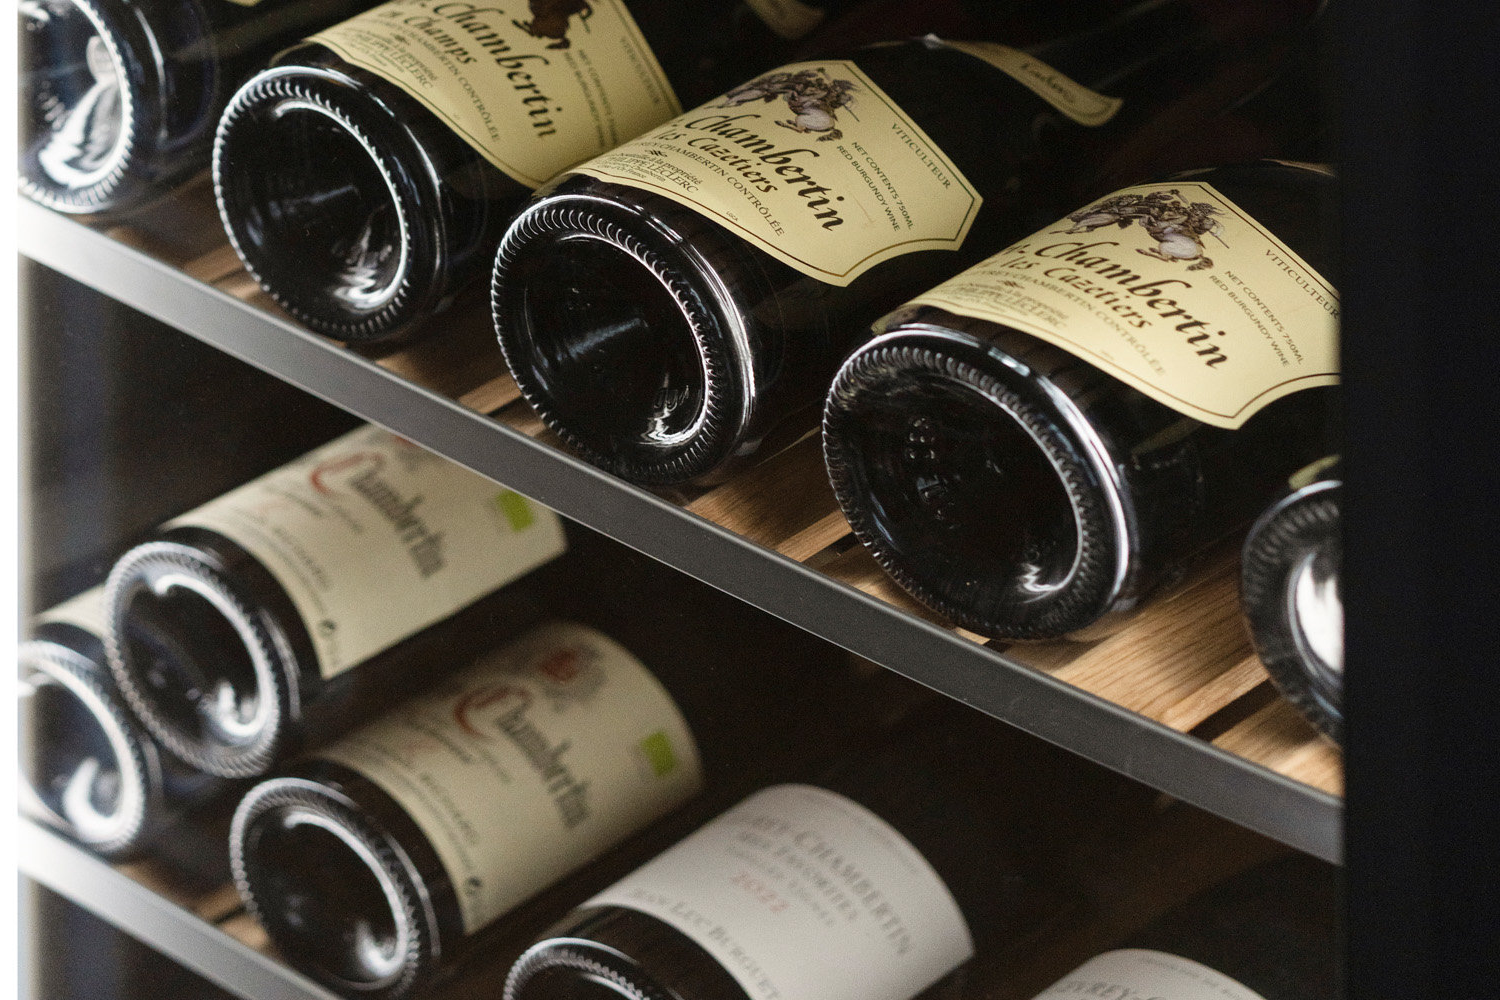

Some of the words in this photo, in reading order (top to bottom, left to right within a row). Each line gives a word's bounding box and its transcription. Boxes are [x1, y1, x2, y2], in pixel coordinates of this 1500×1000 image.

[404, 15, 478, 65] Champs
[433, 3, 563, 138] Chambertin
[647, 161, 700, 194] LECLERC
[684, 113, 845, 232] Chambertin
[686, 137, 779, 195] Cazetiers
[836, 144, 854, 161] RED
[851, 160, 889, 206] BURGUNDY
[884, 206, 901, 232] WINE
[851, 141, 869, 157] NET
[865, 156, 900, 200] CONTENTS
[896, 200, 915, 230] 750ML
[891, 121, 952, 190] VITICULTEUR
[726, 176, 786, 237] CONTRÔLÉE
[1034, 241, 1229, 370] Chambertin
[1043, 267, 1154, 329] Cazetiers
[1208, 274, 1229, 292] RED
[1227, 291, 1274, 341] BURGUNDY
[1270, 341, 1291, 368] WINE
[1224, 269, 1245, 287] NET
[1243, 286, 1285, 333] CONTENTS
[1282, 333, 1305, 366] 750ML
[1265, 248, 1340, 320] VITICULTEUR
